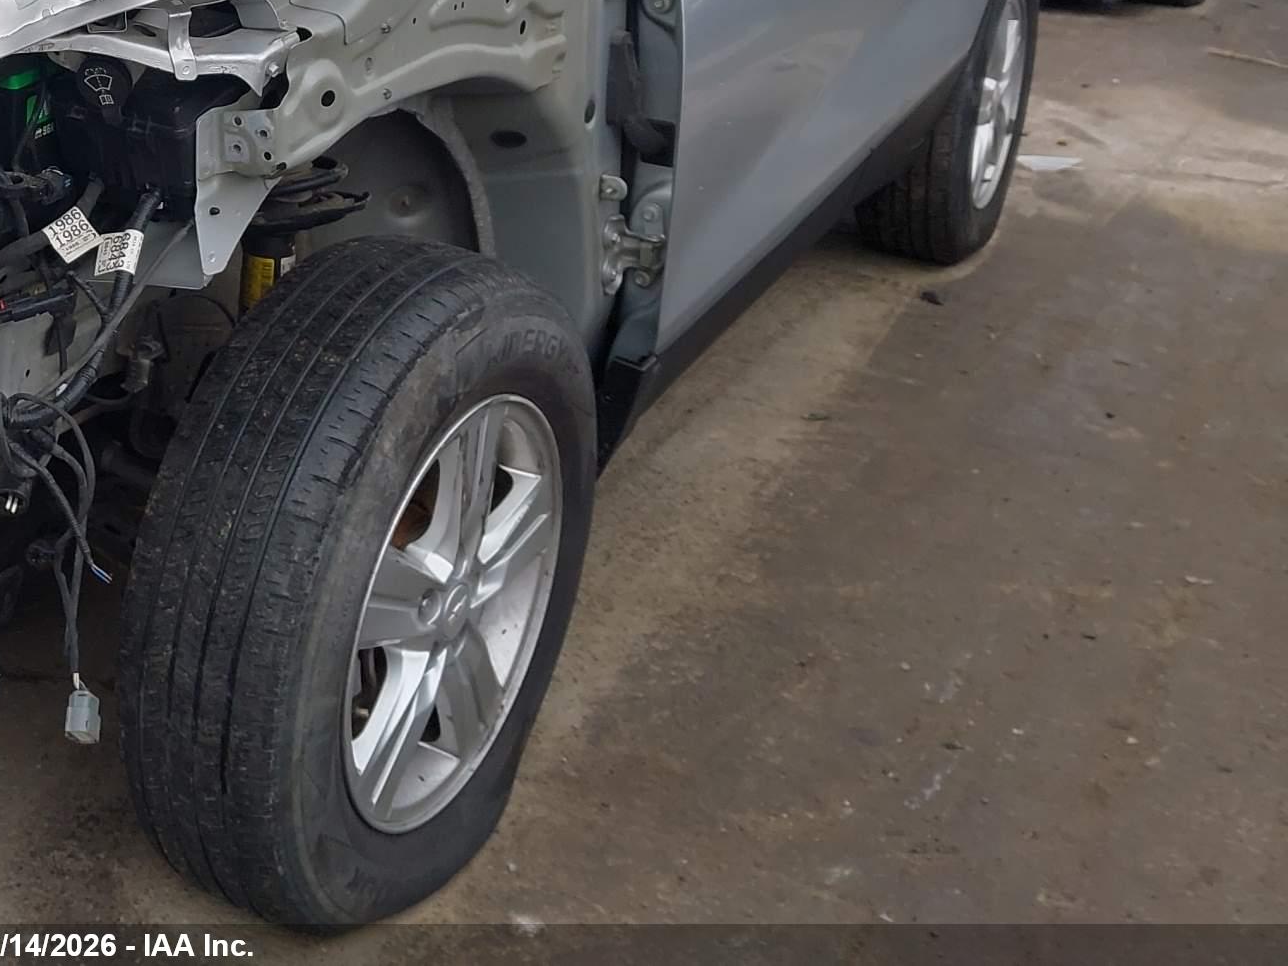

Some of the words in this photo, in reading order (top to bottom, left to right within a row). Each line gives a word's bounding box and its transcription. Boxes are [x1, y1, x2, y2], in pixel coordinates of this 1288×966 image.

[48, 208, 81, 237] 1986
[55, 219, 89, 248] 1986
[106, 235, 123, 271] 6843
